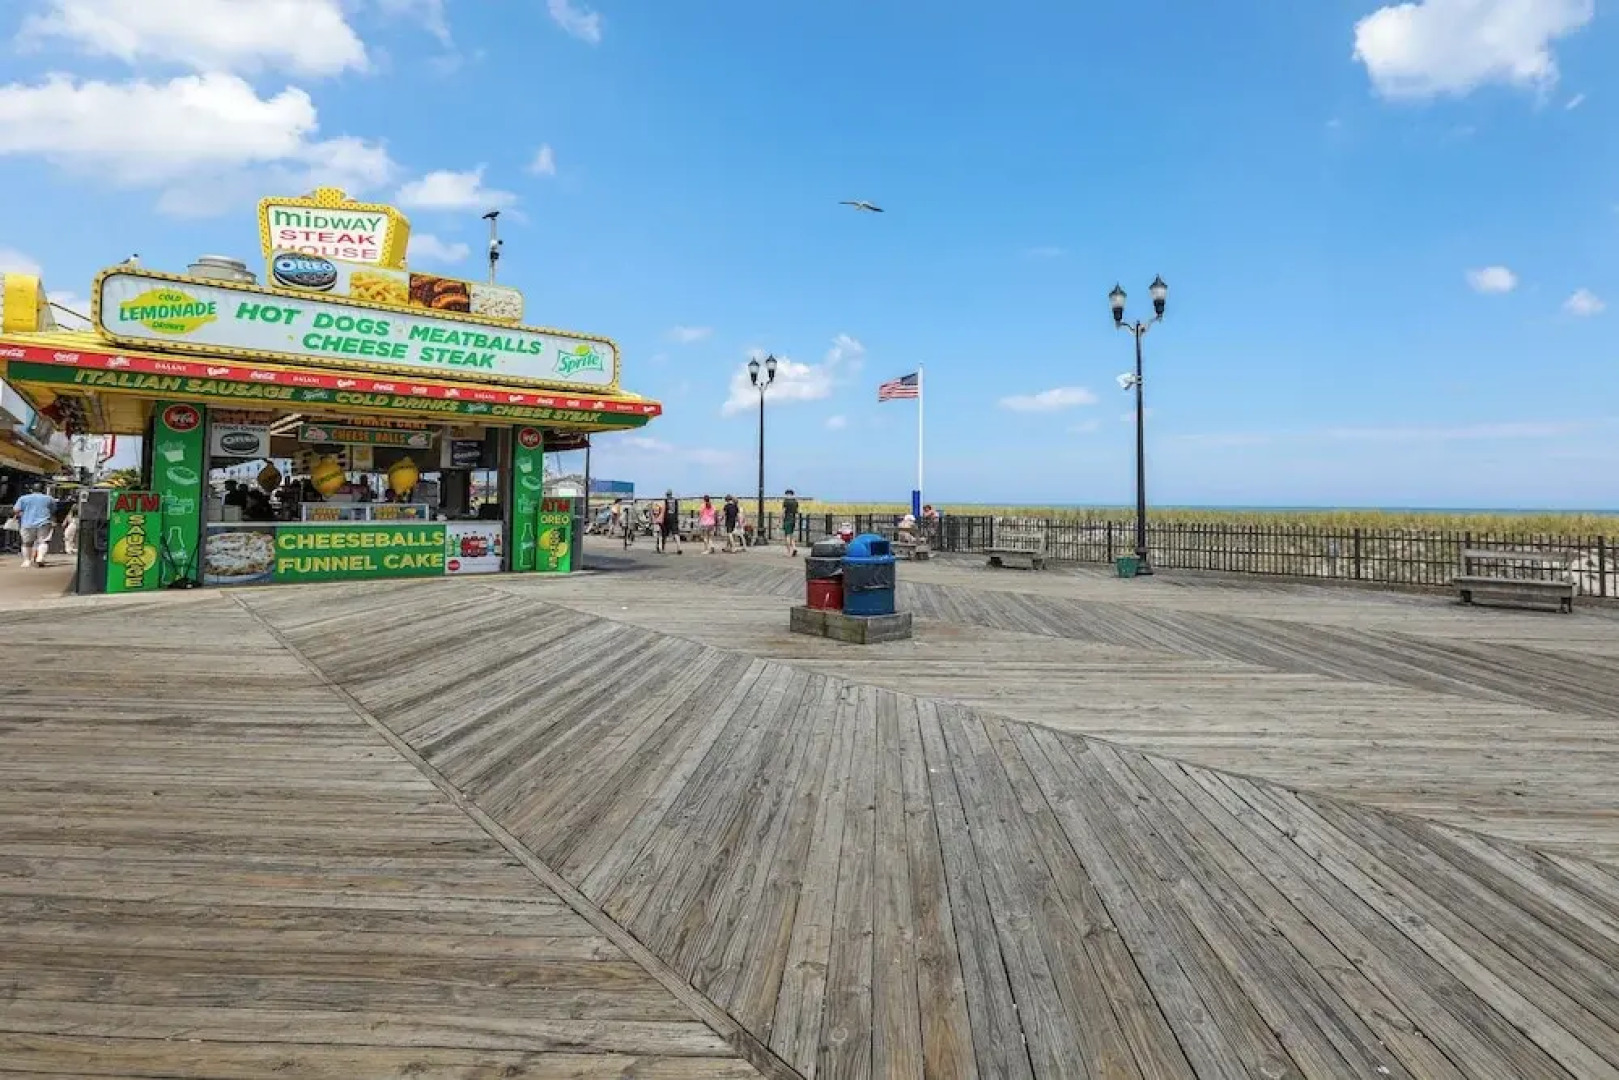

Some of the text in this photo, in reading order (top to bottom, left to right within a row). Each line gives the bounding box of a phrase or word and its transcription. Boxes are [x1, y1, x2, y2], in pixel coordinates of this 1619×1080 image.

[280, 230, 376, 245] STEAK
[276, 260, 334, 273] OREO
[158, 293, 182, 302] COLD
[119, 301, 217, 322] LEMONADE
[236, 302, 542, 355] HOT DOGS MEATBALLS
[302, 333, 496, 369] CHEESE STEAK
[559, 353, 601, 374] Sprite
[74, 370, 182, 391] ITALIAN
[185, 379, 294, 399] SAUSAGE
[336, 391, 389, 406] COLD
[391, 397, 459, 412] DRINKS
[491, 404, 552, 420] CHEESE
[553, 408, 602, 422] STEAK
[113, 493, 161, 513] ATM
[541, 498, 571, 513] ATM
[540, 514, 569, 525] OREO
[278, 531, 444, 550] CHEESEBALLS
[125, 514, 145, 588] SAUSAGE
[278, 553, 443, 574] FUNNEL CAKE
